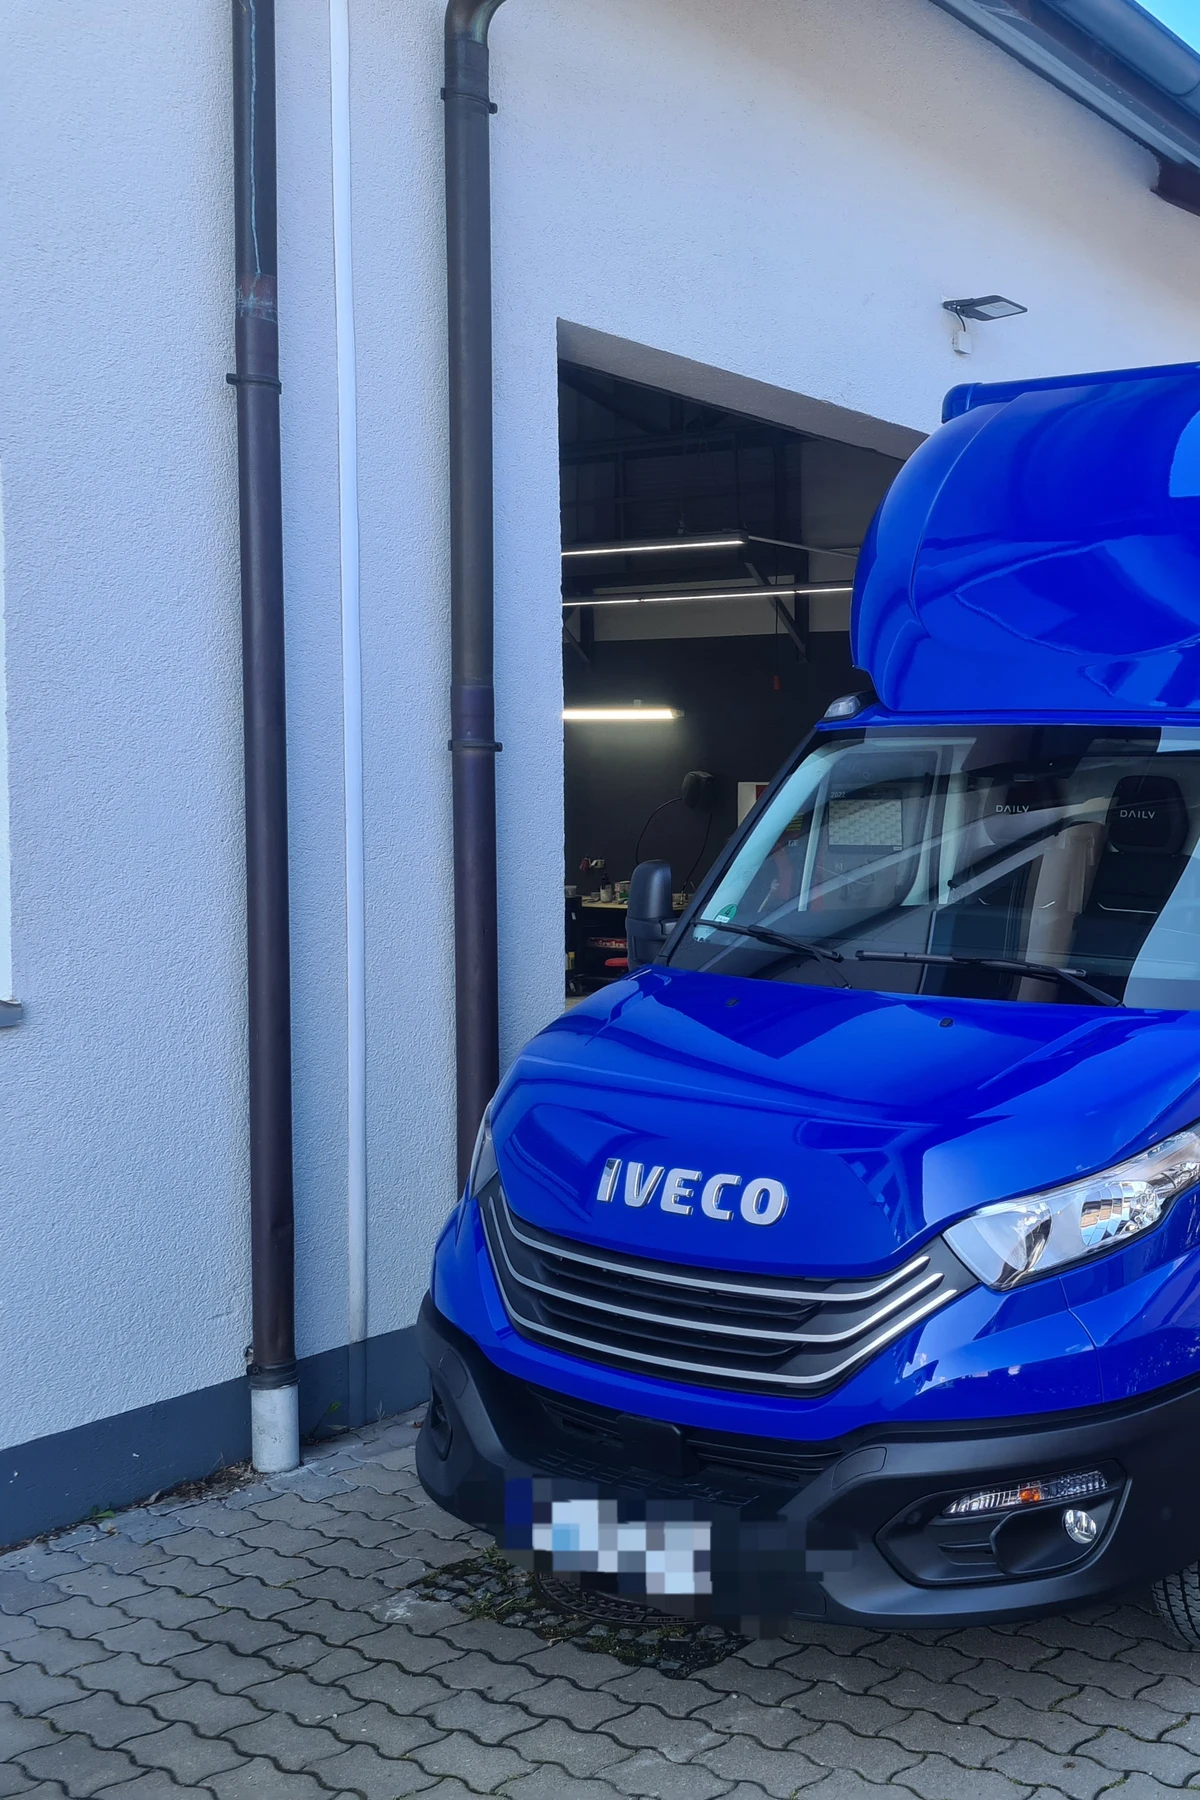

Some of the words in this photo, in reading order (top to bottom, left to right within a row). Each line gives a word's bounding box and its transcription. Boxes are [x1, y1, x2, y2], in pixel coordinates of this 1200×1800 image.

[995, 804, 1030, 813] DAILY
[1120, 809, 1156, 819] DAILY
[596, 1157, 789, 1227] IVECO
